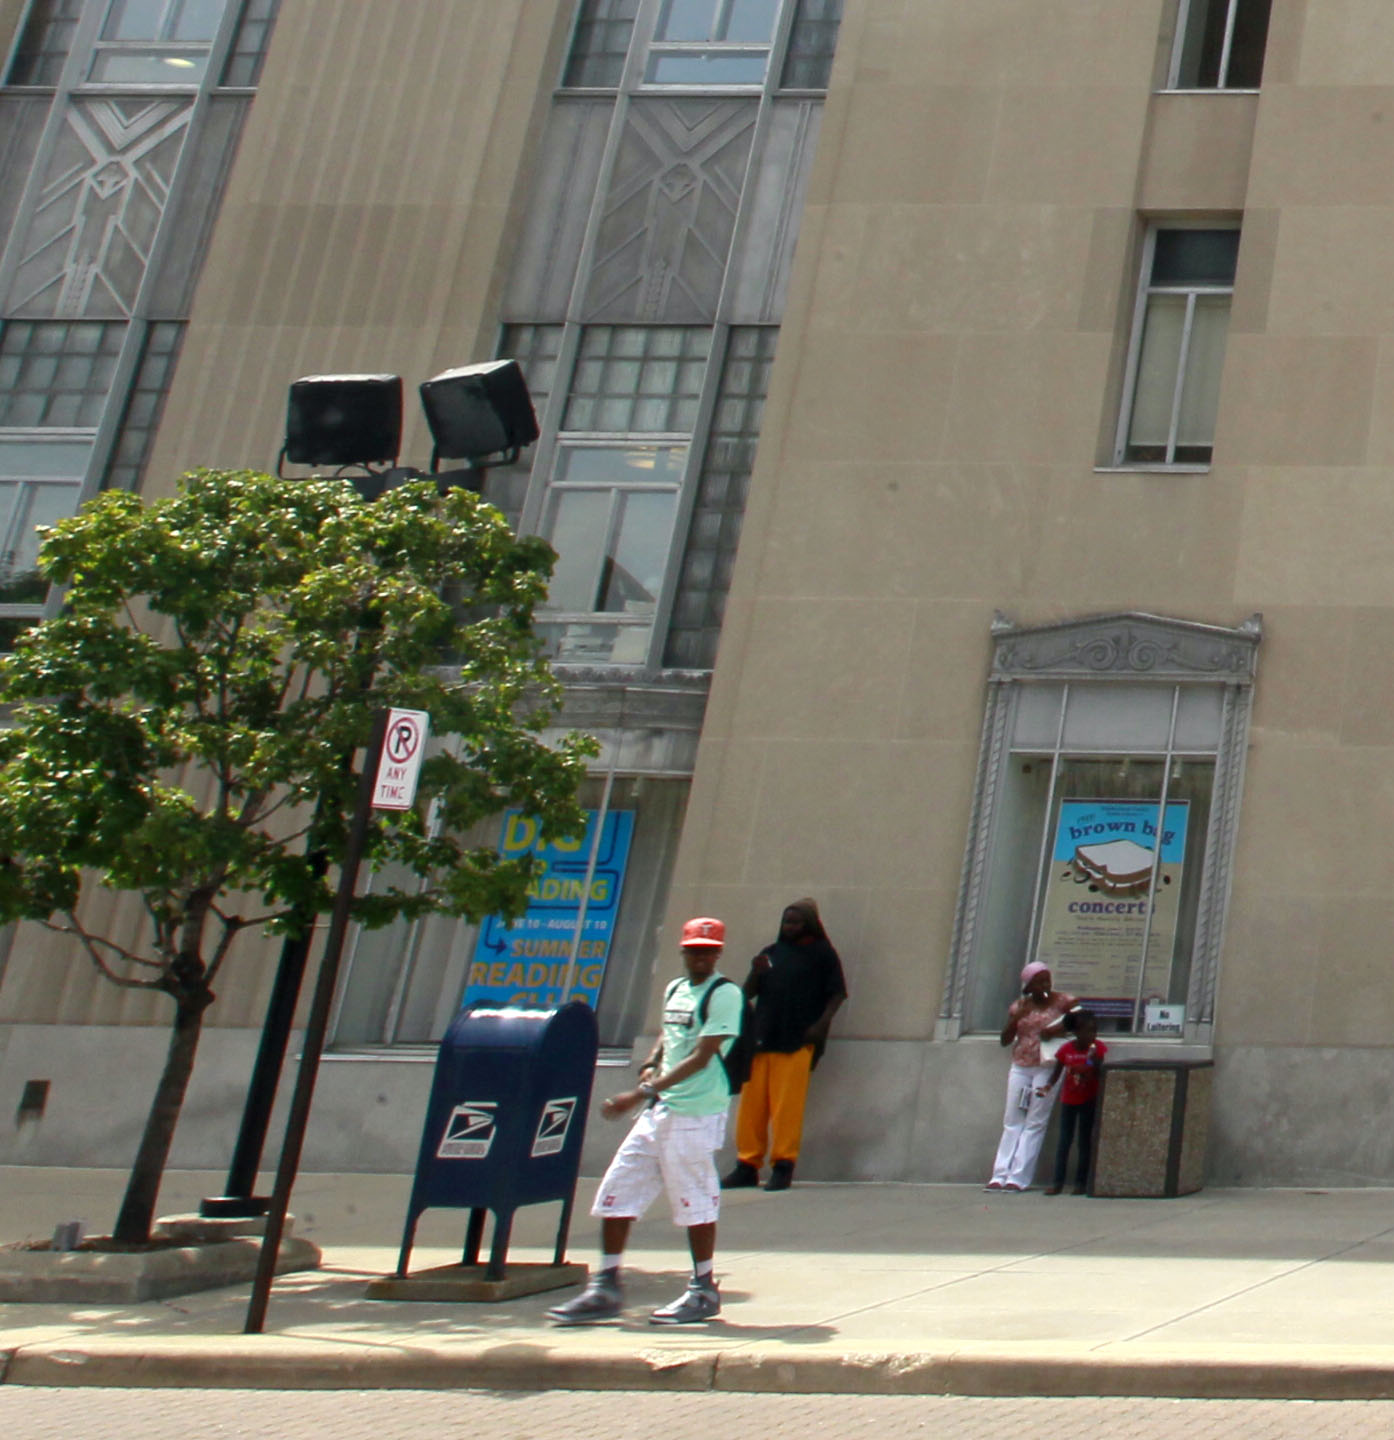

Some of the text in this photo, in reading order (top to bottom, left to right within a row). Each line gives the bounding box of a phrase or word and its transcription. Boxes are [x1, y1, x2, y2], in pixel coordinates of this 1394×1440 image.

[386, 767, 407, 781] ANY
[381, 784, 405, 800] TIME
[1069, 821, 1136, 840] brown
[524, 878, 609, 902] ADING
[547, 919, 591, 930] AUGUT
[511, 939, 607, 958] SUMMER
[468, 961, 602, 988] READING
